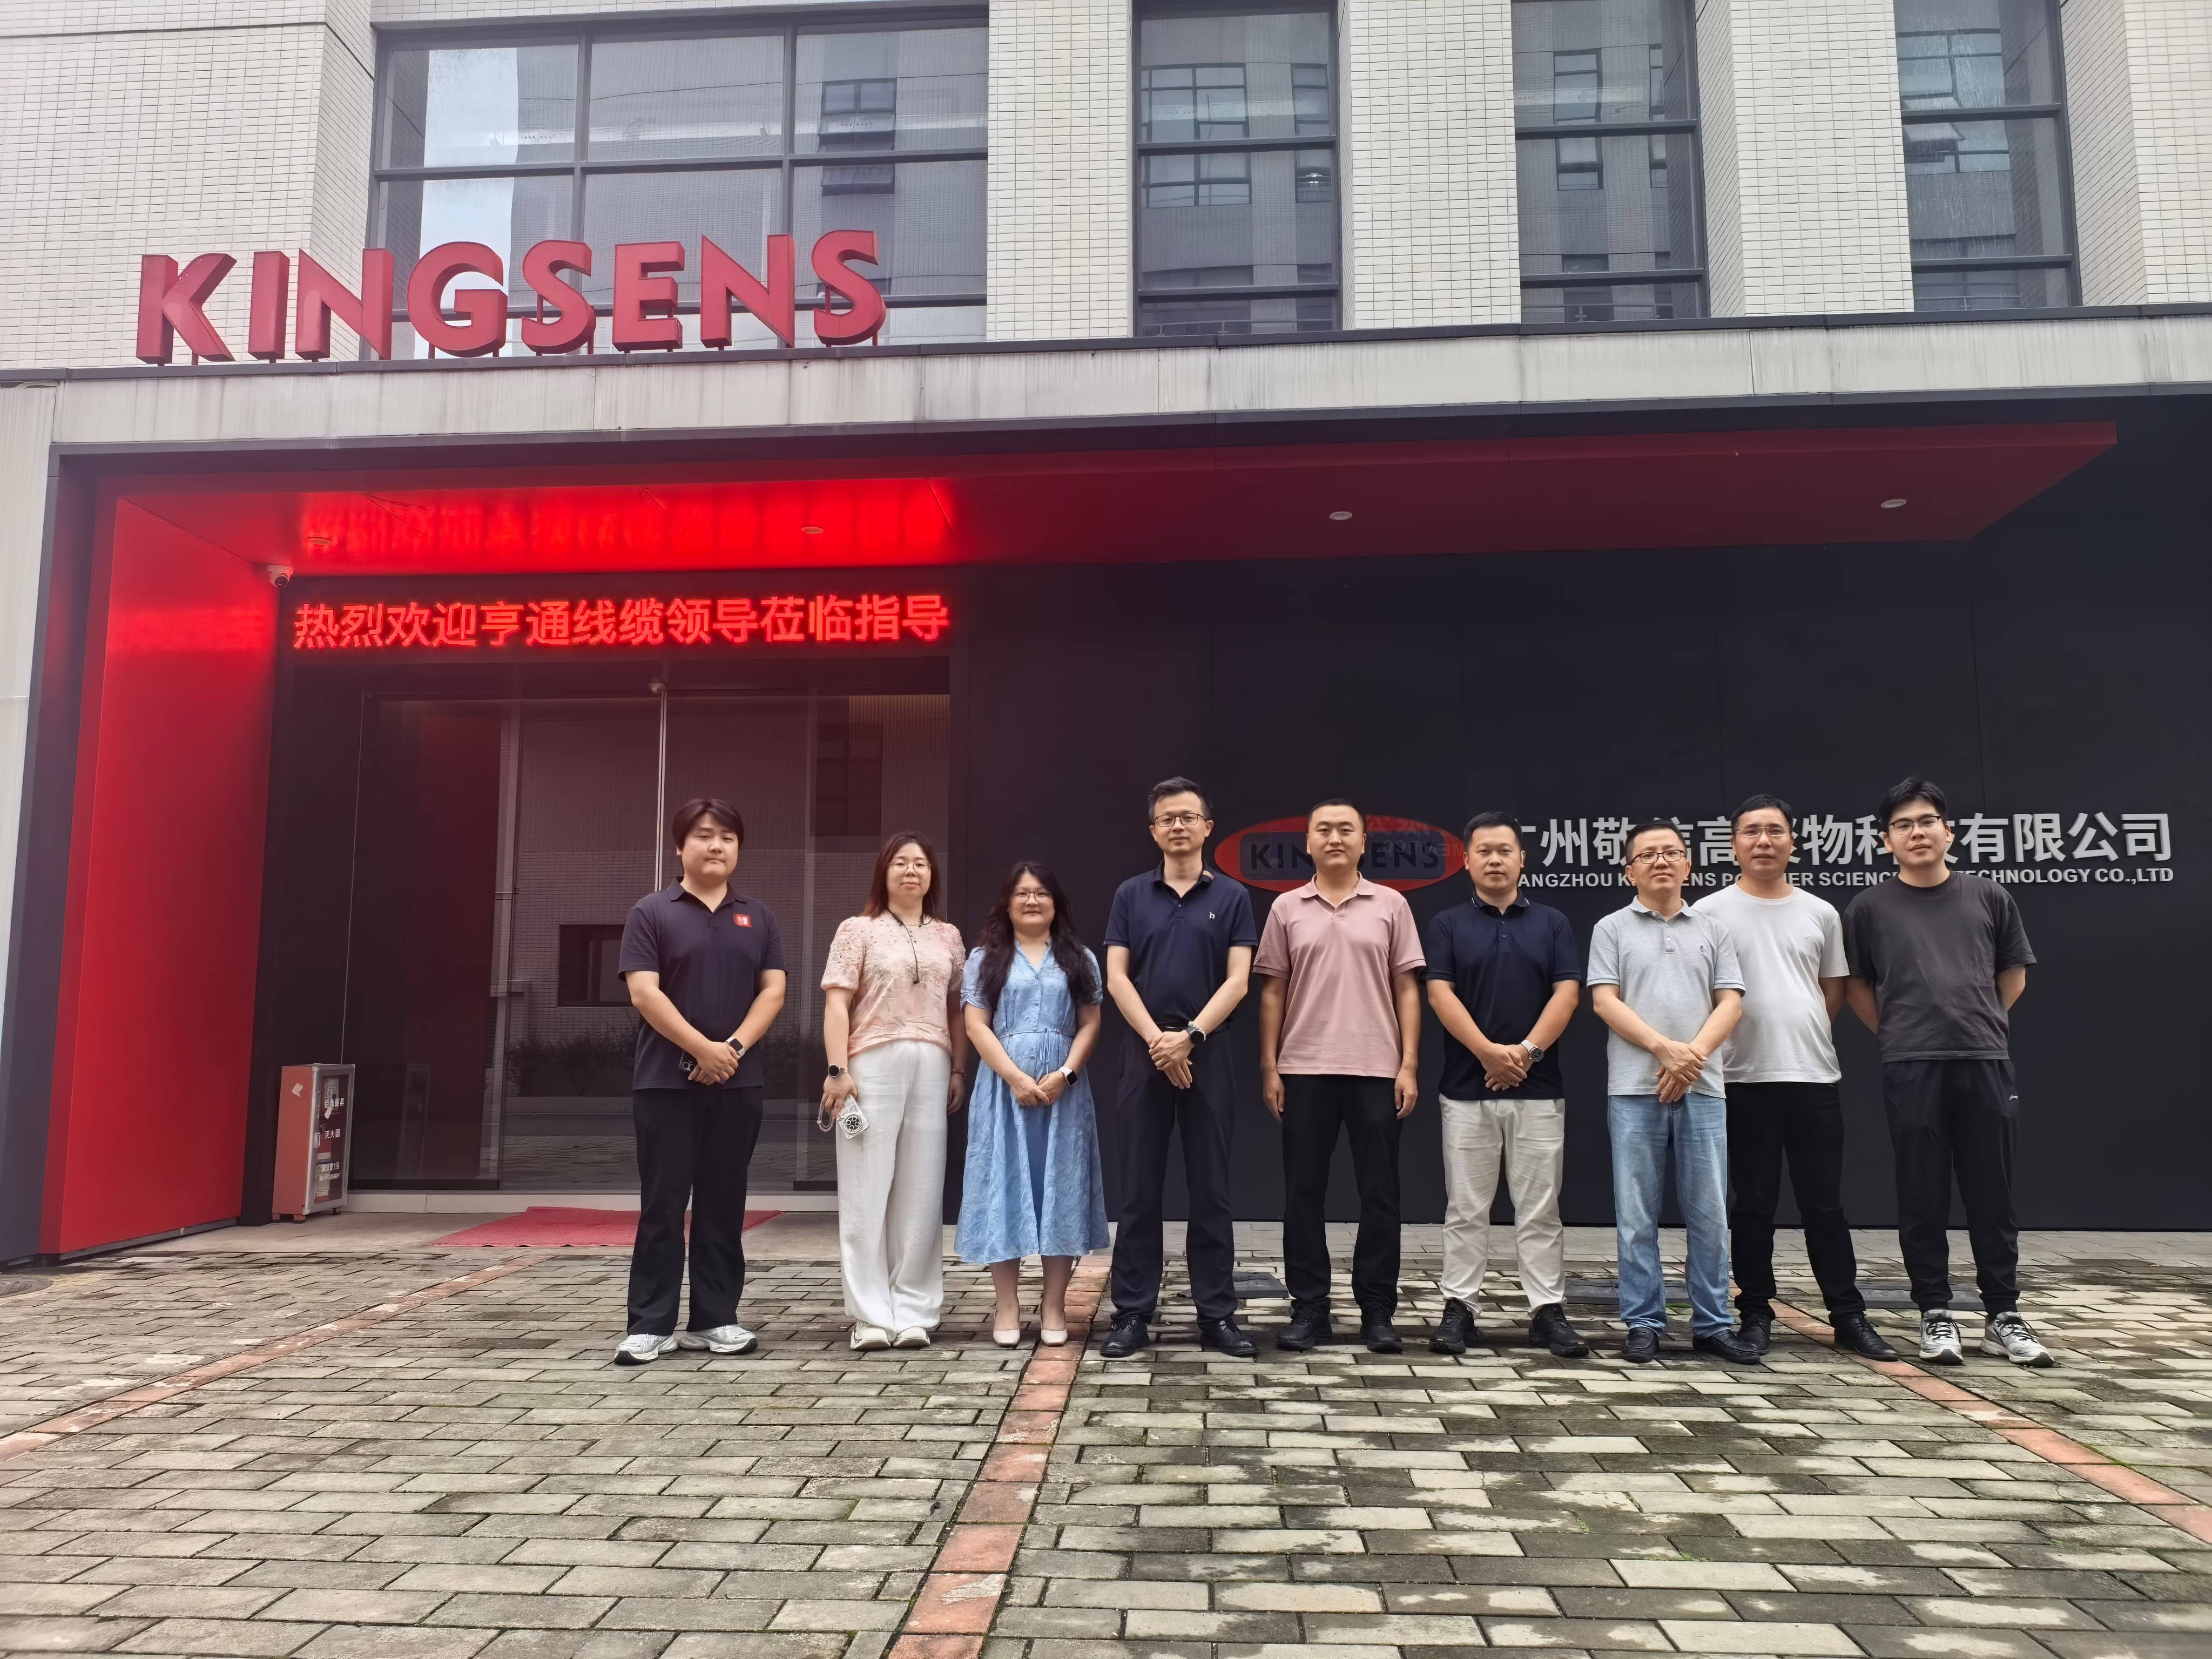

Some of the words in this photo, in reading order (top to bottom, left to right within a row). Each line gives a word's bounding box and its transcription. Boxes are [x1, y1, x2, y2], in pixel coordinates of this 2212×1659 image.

[136, 230, 887, 364] KINGSENS
[294, 595, 949, 648] 热烈欢迎亨通线缆领导莅临指导
[1251, 843, 1439, 868] KINENS
[1518, 873, 1611, 887] ANGZHOU
[1818, 872, 1898, 886] SCIENC
[325, 1129, 340, 1139] 灭火器
